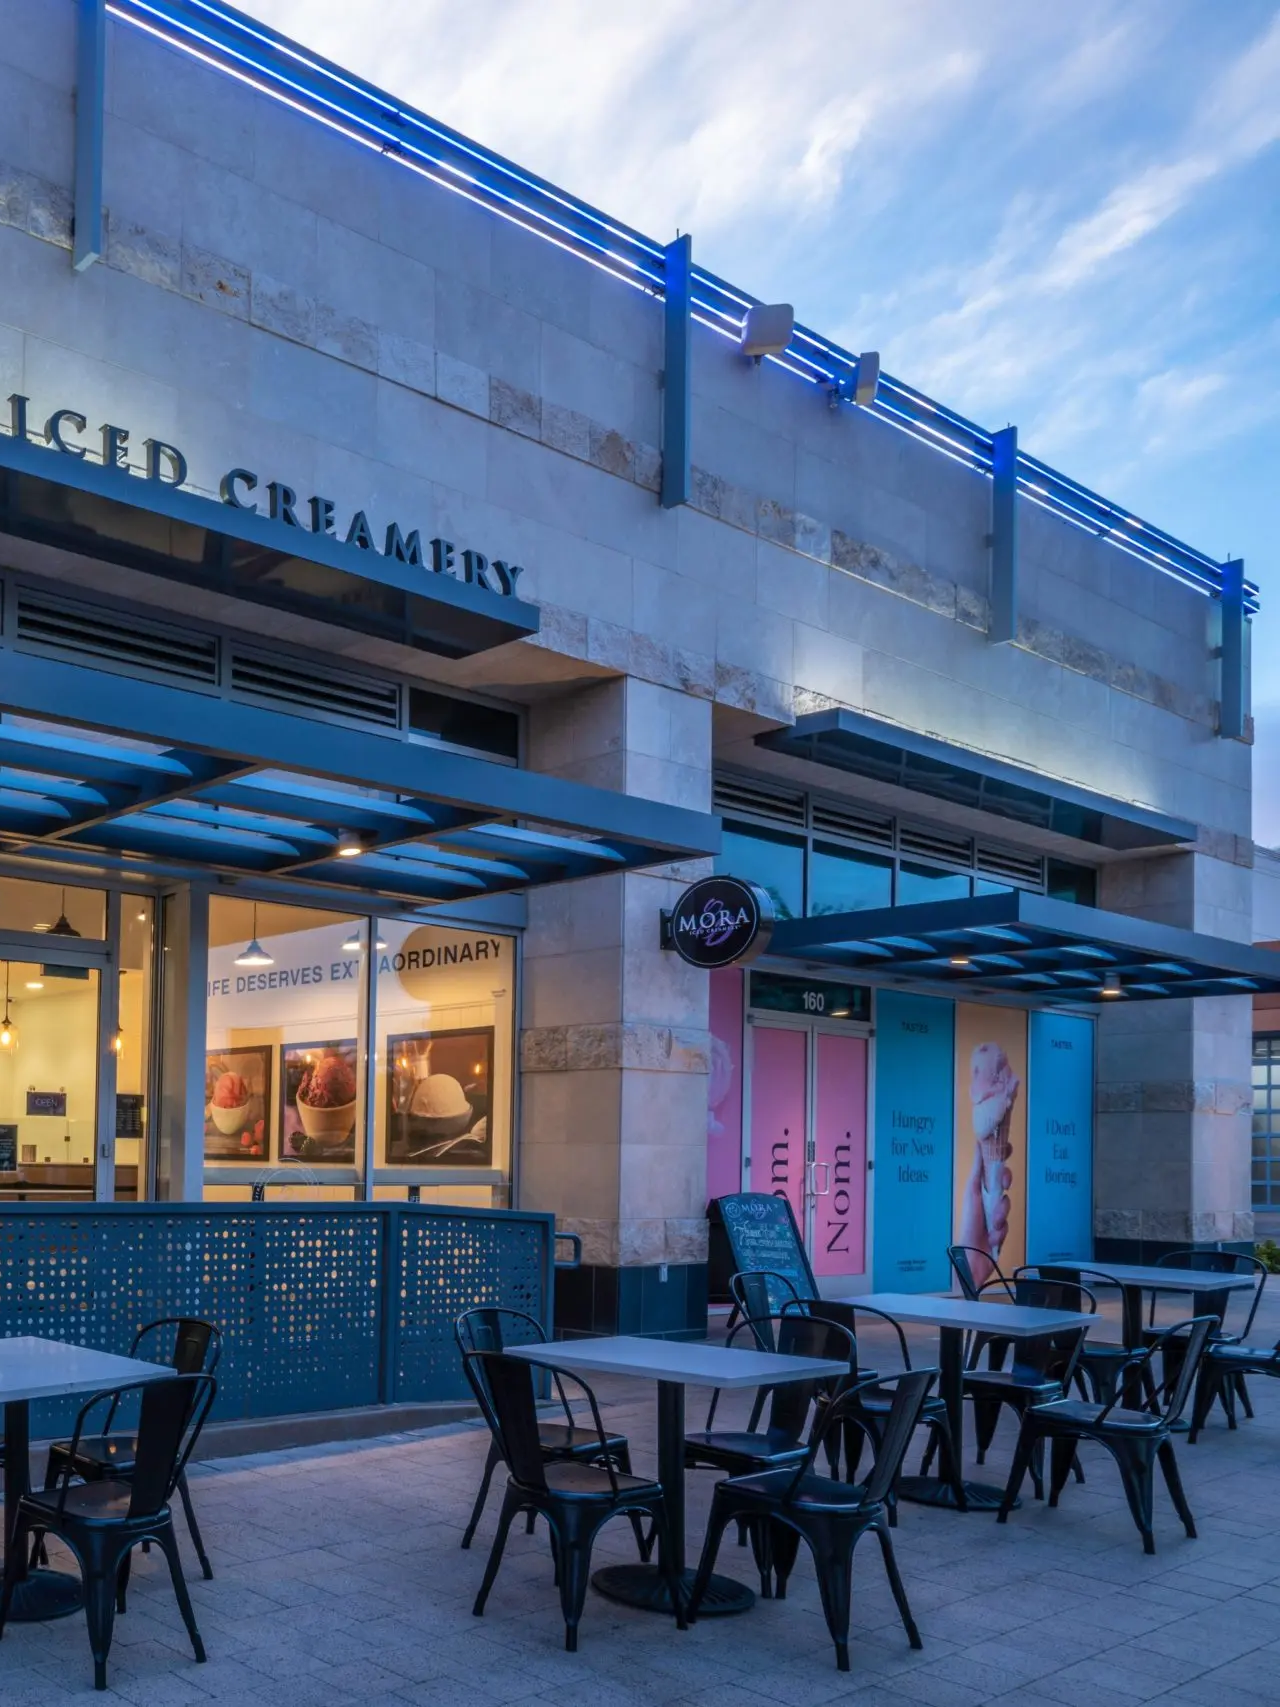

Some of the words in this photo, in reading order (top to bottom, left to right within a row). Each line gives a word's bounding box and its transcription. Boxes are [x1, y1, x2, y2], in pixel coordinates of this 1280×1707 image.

[7, 393, 188, 489] ICED
[220, 468, 524, 597] CREAMERY
[679, 907, 751, 932] MORA
[208, 979, 230, 996] IFE
[236, 966, 323, 994] DESERVES
[331, 939, 500, 981] EXAORDINARY
[803, 991, 824, 1012] 160
[901, 1021, 929, 1034] TASTES
[1051, 1039, 1073, 1050] TASTES
[892, 1110, 936, 1134] Hungry
[891, 1137, 910, 1157] for
[912, 1139, 935, 1157] New
[898, 1165, 930, 1183] Ideas
[1045, 1170, 1078, 1187] Boring
[826, 1131, 851, 1254] Nom.
